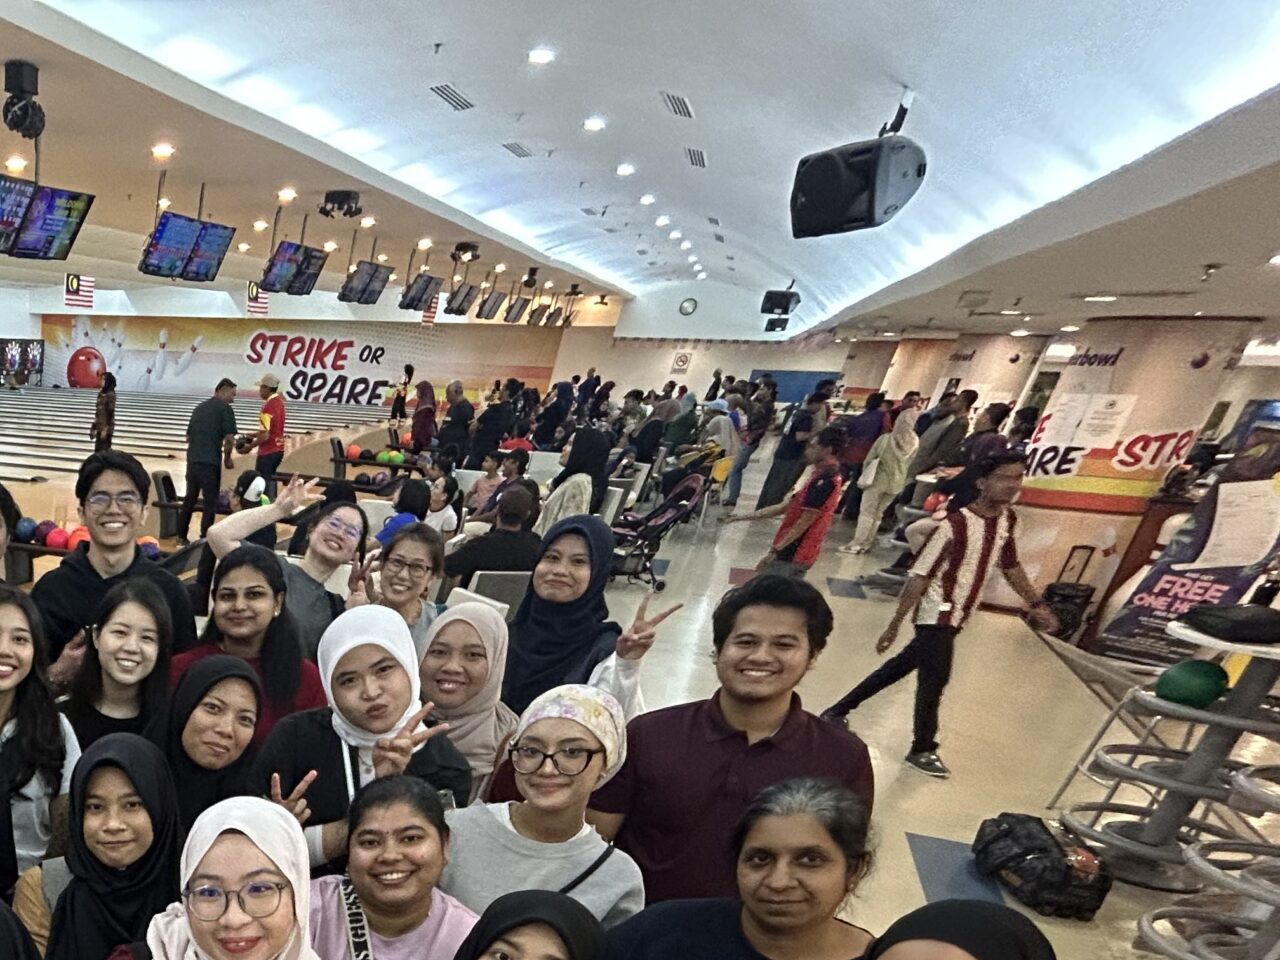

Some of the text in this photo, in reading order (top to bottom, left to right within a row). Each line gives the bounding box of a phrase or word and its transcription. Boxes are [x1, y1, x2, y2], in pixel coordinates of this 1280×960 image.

[246, 332, 385, 371] STRIKE OR
[286, 370, 389, 407] SPARE
[1133, 593, 1169, 611] ONE
[1153, 574, 1232, 604] FREE
